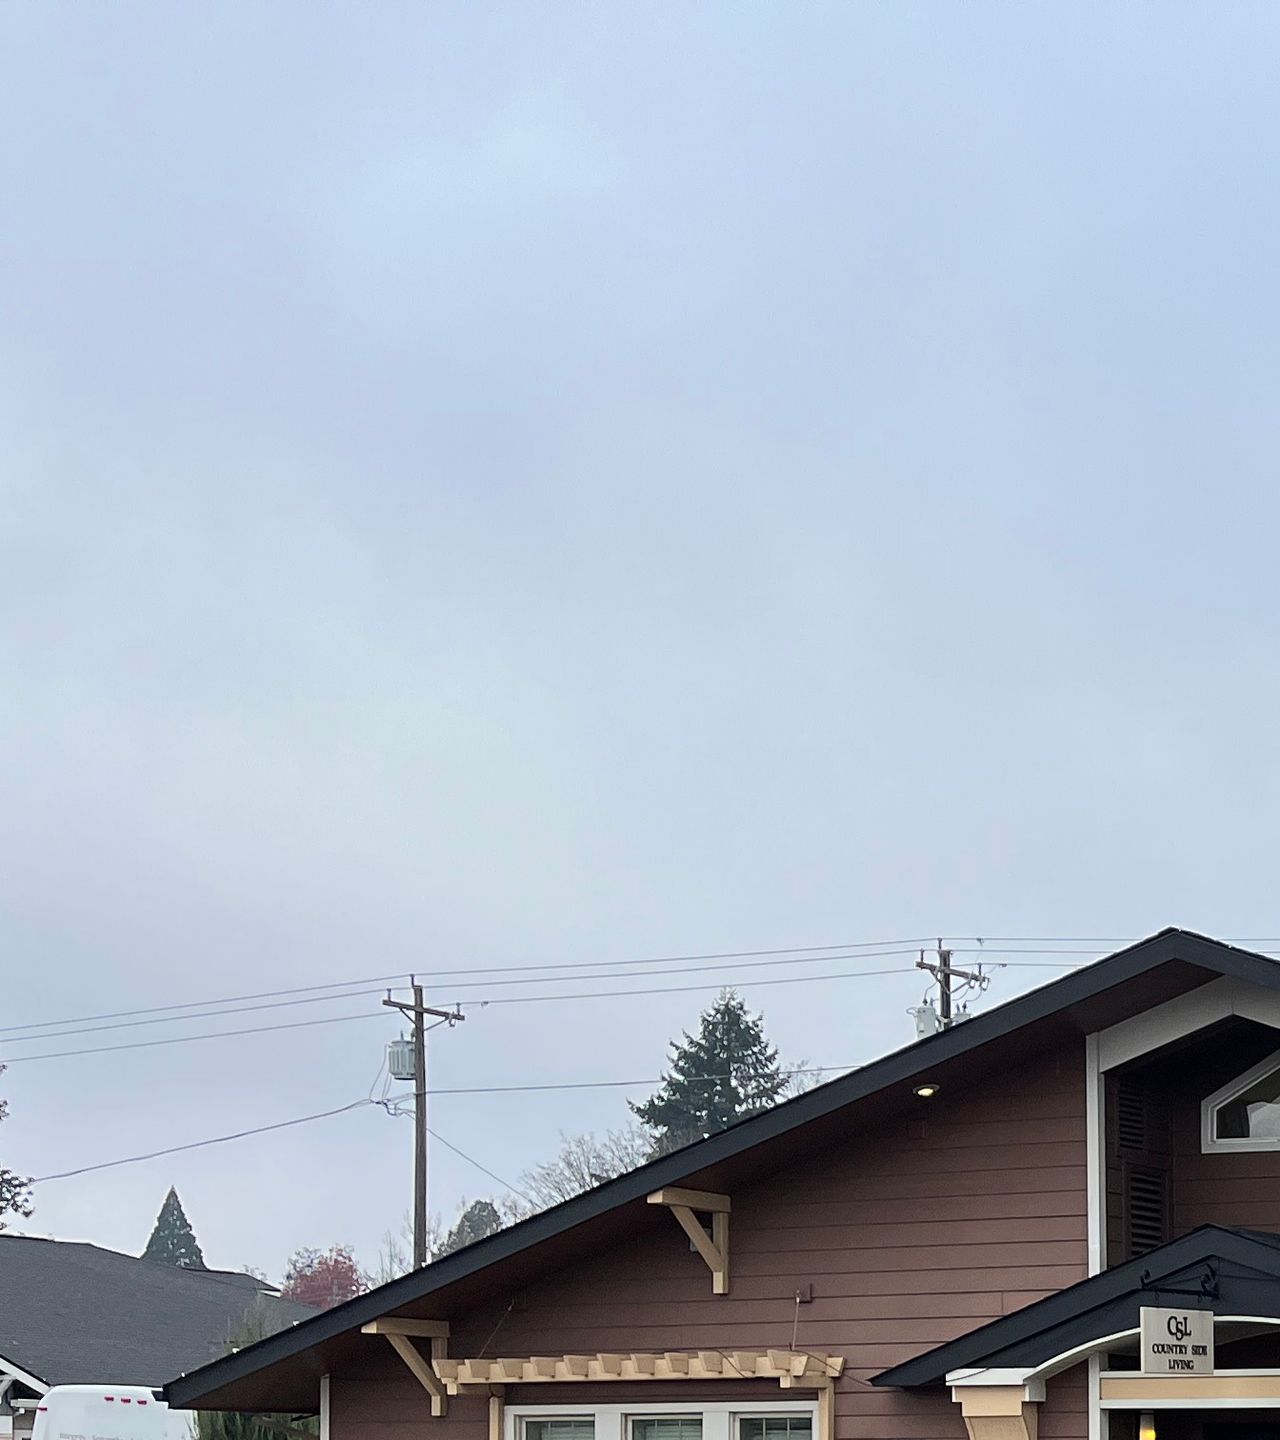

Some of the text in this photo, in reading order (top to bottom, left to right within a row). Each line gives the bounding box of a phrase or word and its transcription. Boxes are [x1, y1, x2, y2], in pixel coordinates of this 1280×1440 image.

[1167, 1315, 1192, 1341] CSL
[1152, 1343, 1208, 1355] COUNTRY SIDE
[1168, 1359, 1194, 1370] LIVING
